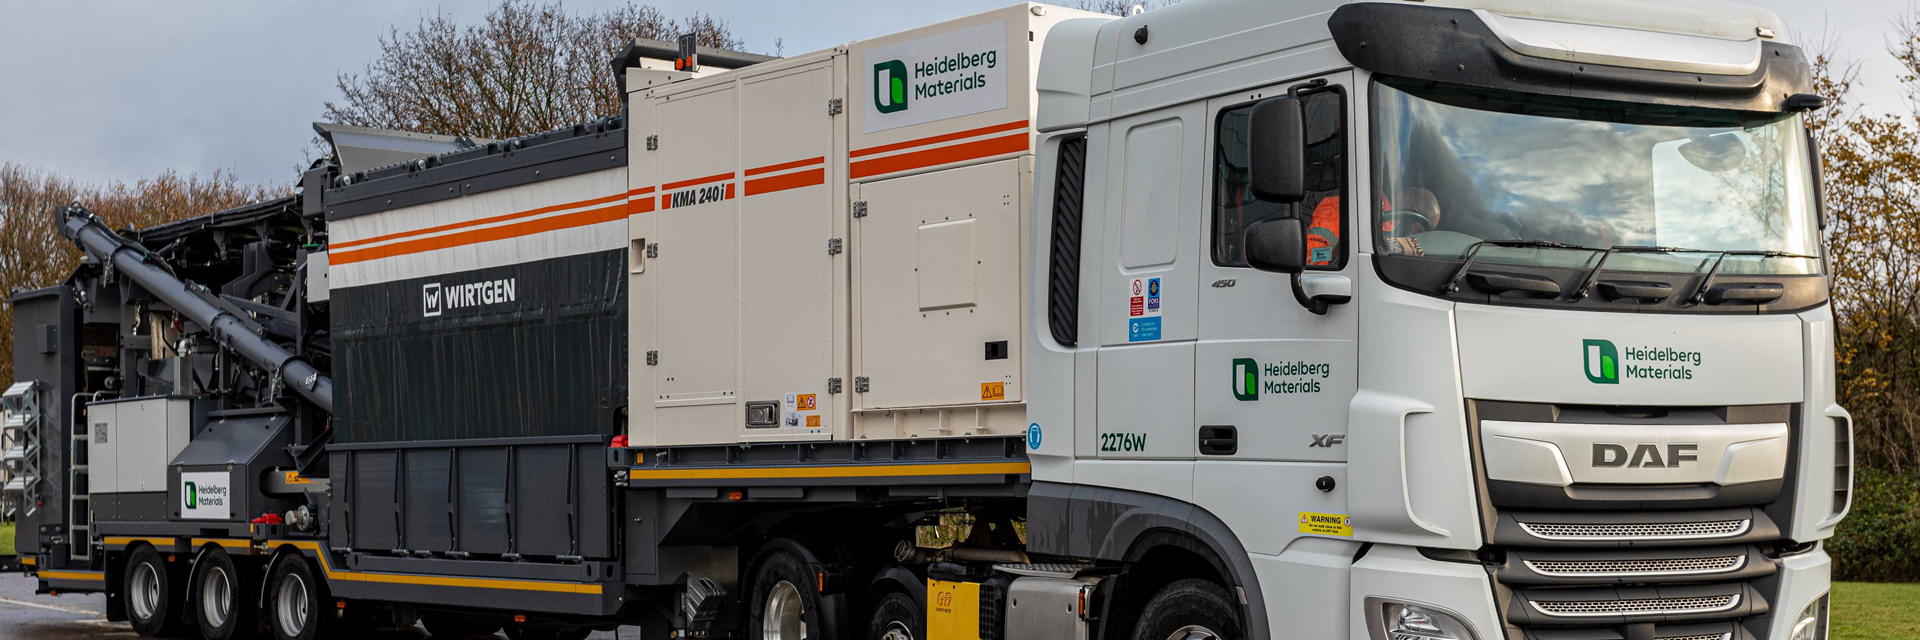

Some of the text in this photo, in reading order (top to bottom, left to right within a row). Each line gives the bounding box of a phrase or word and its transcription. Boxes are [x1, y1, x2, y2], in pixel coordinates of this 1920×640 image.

[915, 50, 996, 79] Heidelberg
[915, 71, 986, 100] Materials
[672, 190, 696, 208] KMA
[1211, 279, 1236, 288] 450
[445, 278, 515, 309] WIRTGEN
[1625, 346, 1701, 366] Heidelberg
[1264, 361, 1329, 378] Heidelberg
[1626, 364, 1692, 380] Materials
[1264, 378, 1320, 394] Materials
[1101, 432, 1147, 452] 2276W
[1309, 433, 1345, 447] XF
[1592, 442, 1698, 468] DAF
[198, 485, 227, 497] Heidelberg
[198, 495, 224, 506] Materials
[1311, 515, 1341, 524] WARNING
